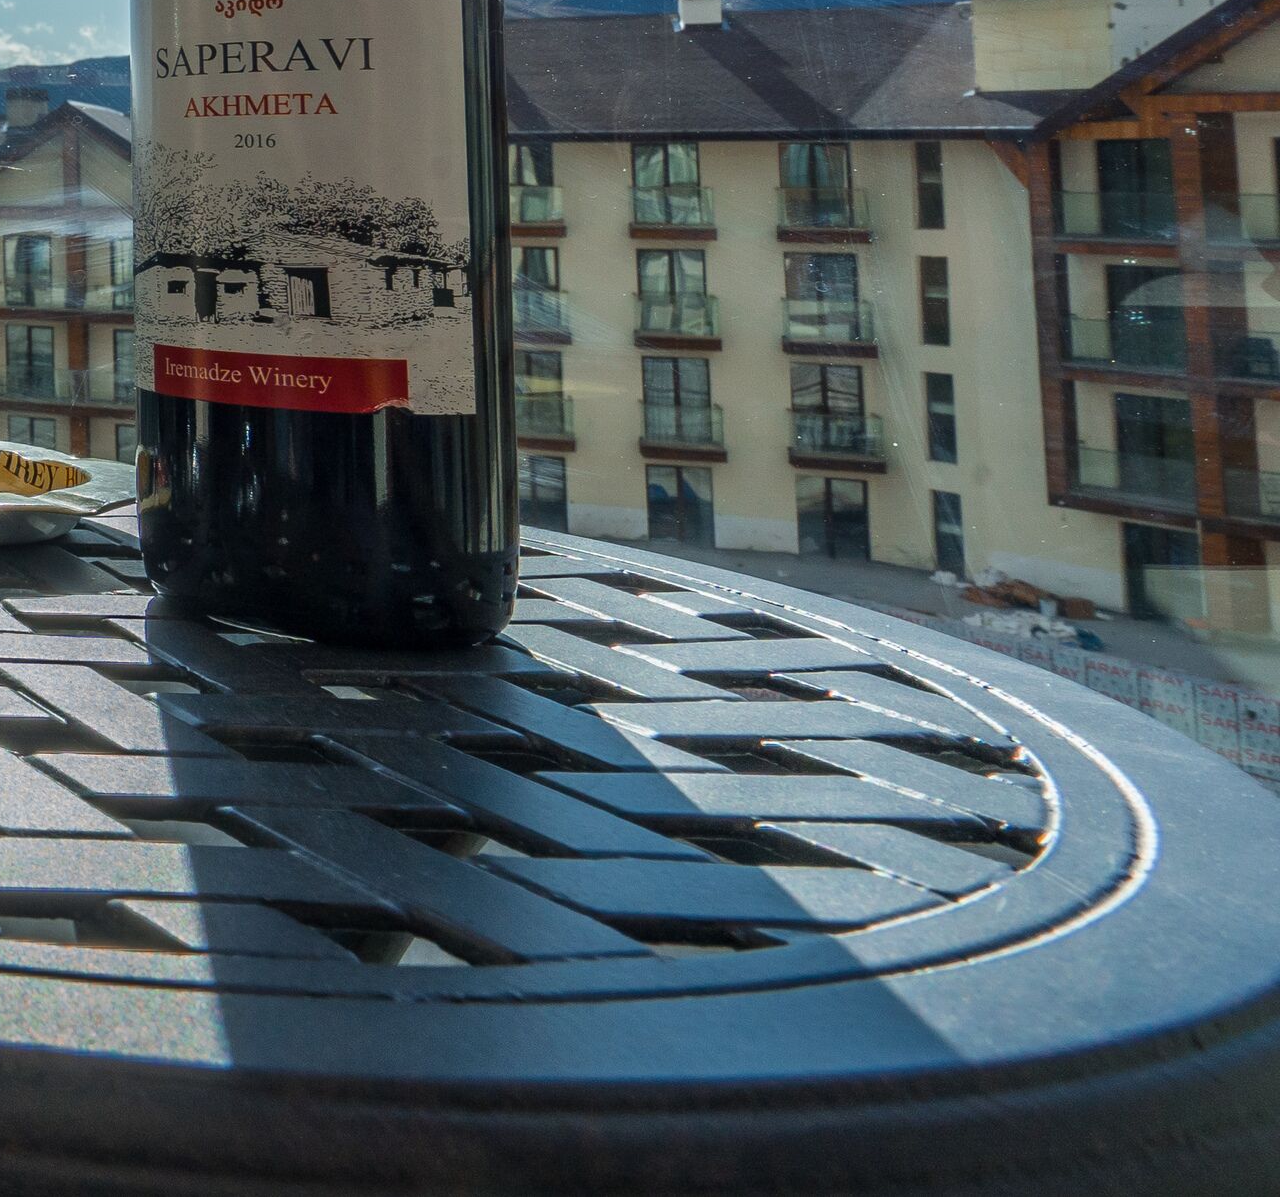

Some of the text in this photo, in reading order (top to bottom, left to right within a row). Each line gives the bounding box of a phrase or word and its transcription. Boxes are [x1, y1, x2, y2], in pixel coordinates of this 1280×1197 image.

[155, 37, 376, 79] SAPERAVI
[183, 92, 339, 118] AKHMETA
[234, 133, 277, 149] 2016
[165, 357, 333, 394] Iremadze Winery
